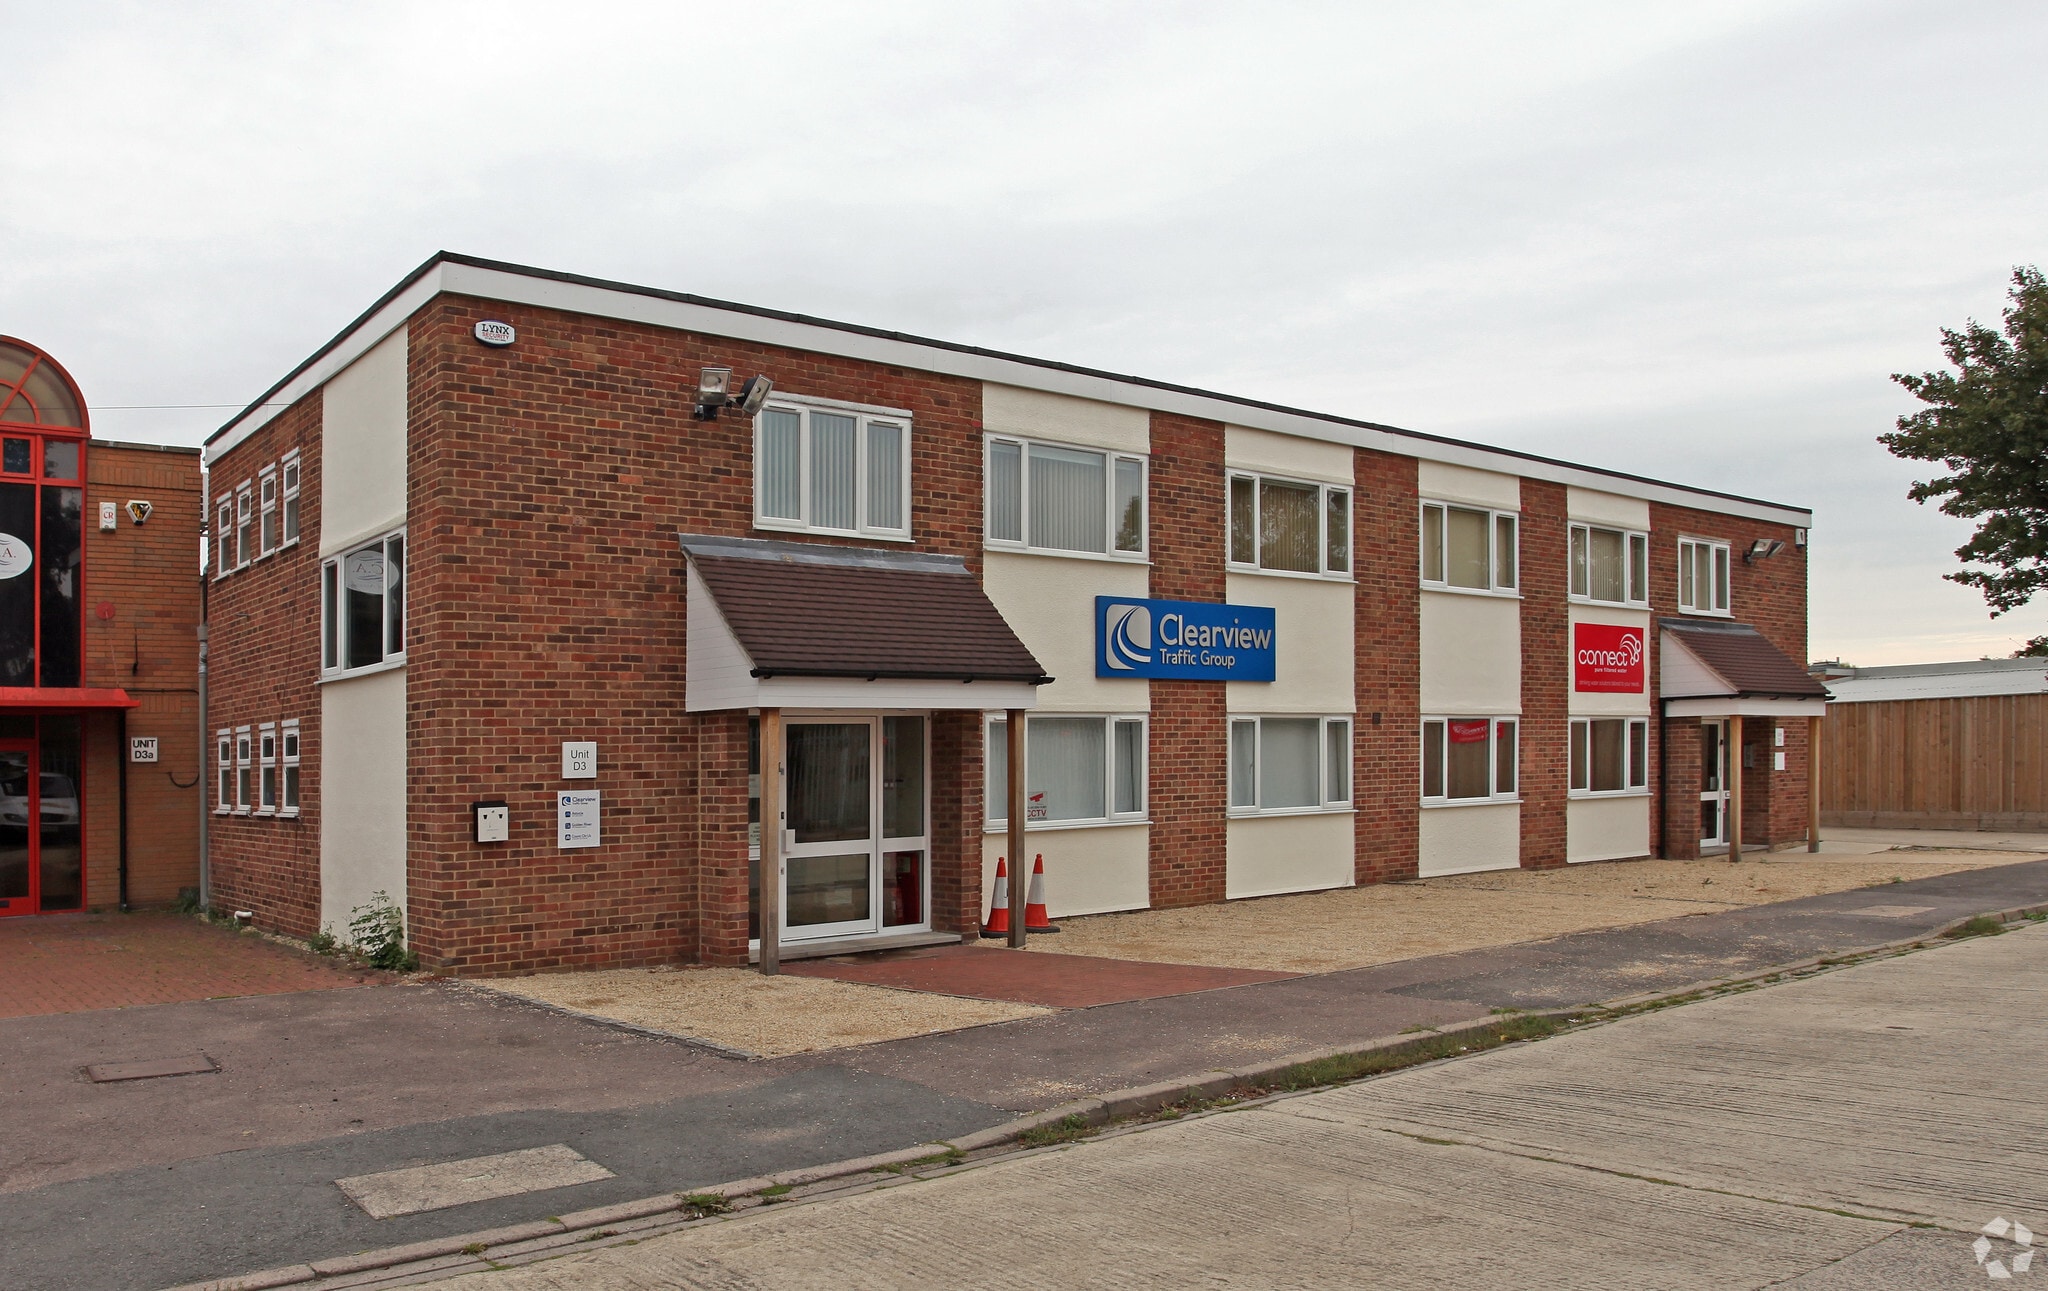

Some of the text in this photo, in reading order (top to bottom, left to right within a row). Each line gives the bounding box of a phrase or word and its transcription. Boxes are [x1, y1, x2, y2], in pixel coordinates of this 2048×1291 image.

[481, 324, 509, 335] LYNX
[482, 332, 509, 340] SECURITY
[1159, 613, 1272, 650] Clearview
[1160, 648, 1236, 669] Traffic Group
[1578, 650, 1628, 666] connect
[132, 739, 156, 748] UNIT
[135, 750, 154, 759] D3a
[571, 750, 589, 759] Unit
[573, 762, 587, 771] D3
